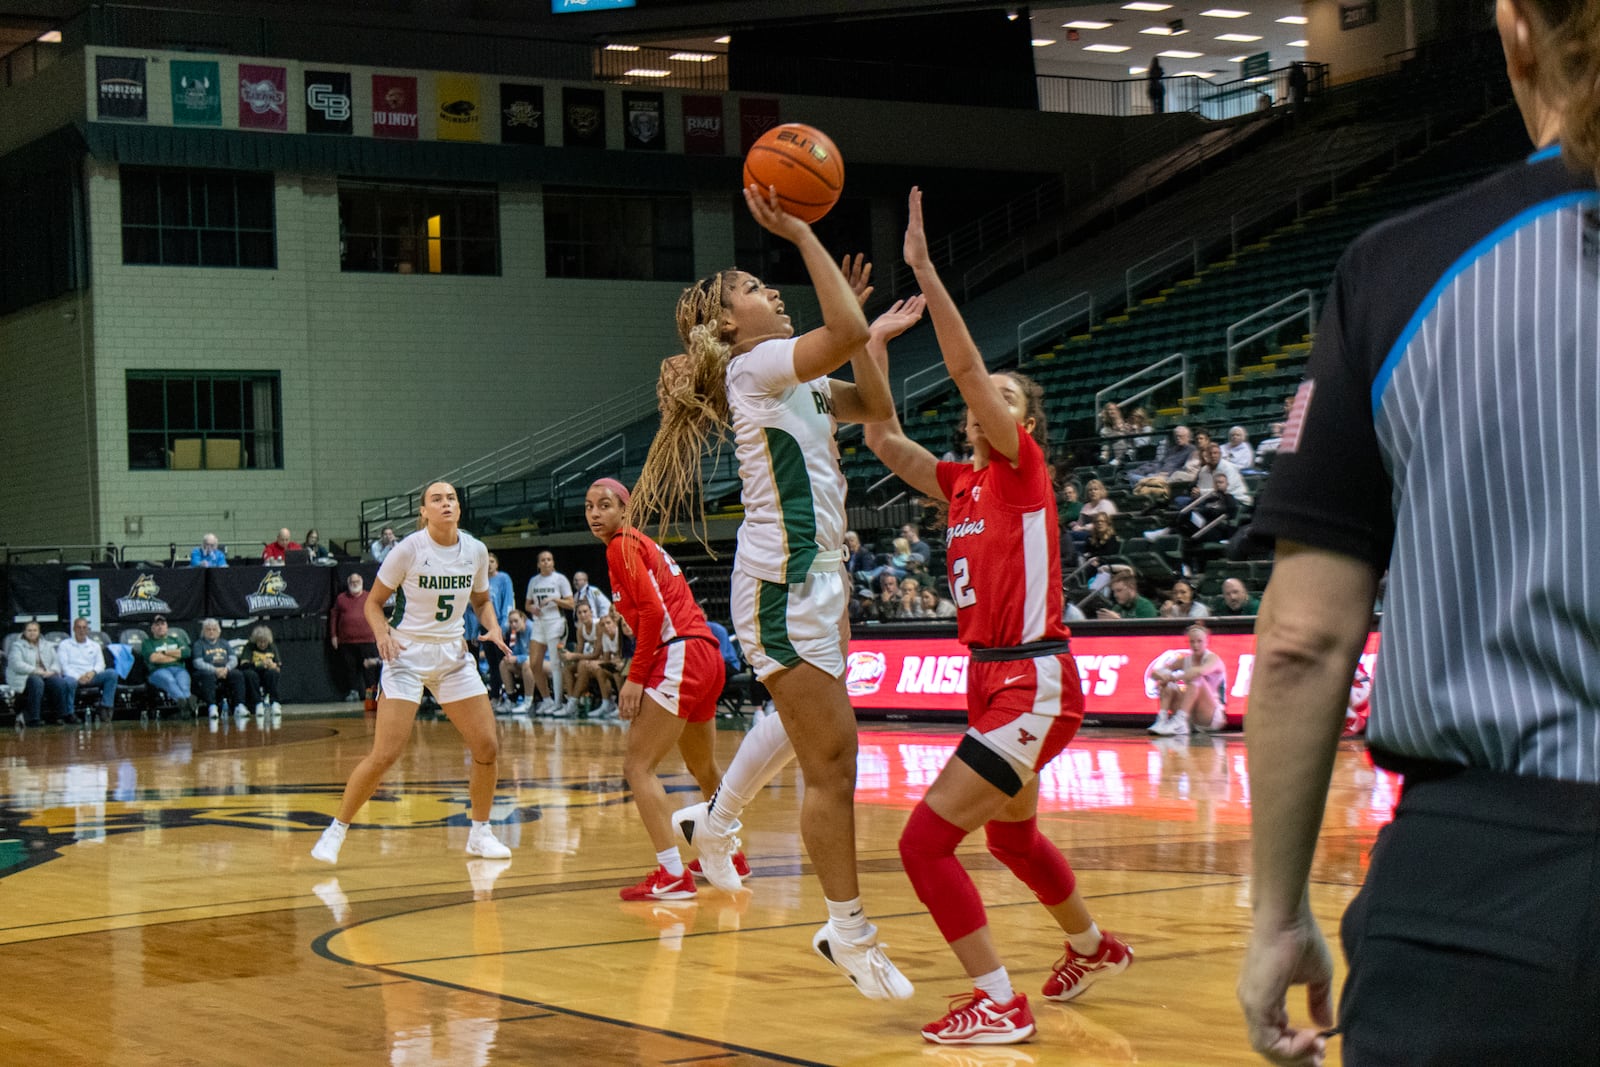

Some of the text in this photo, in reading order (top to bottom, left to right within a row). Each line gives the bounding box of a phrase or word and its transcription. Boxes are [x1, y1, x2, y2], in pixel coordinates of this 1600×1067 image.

[101, 84, 143, 94] HORIZON
[307, 84, 350, 120] GB
[388, 113, 418, 127] INDY
[688, 116, 720, 131] RMU
[418, 574, 473, 590] RAIDERS
[77, 584, 91, 617] CLUB
[435, 594, 456, 622] 5
[896, 655, 970, 695] RAISI
